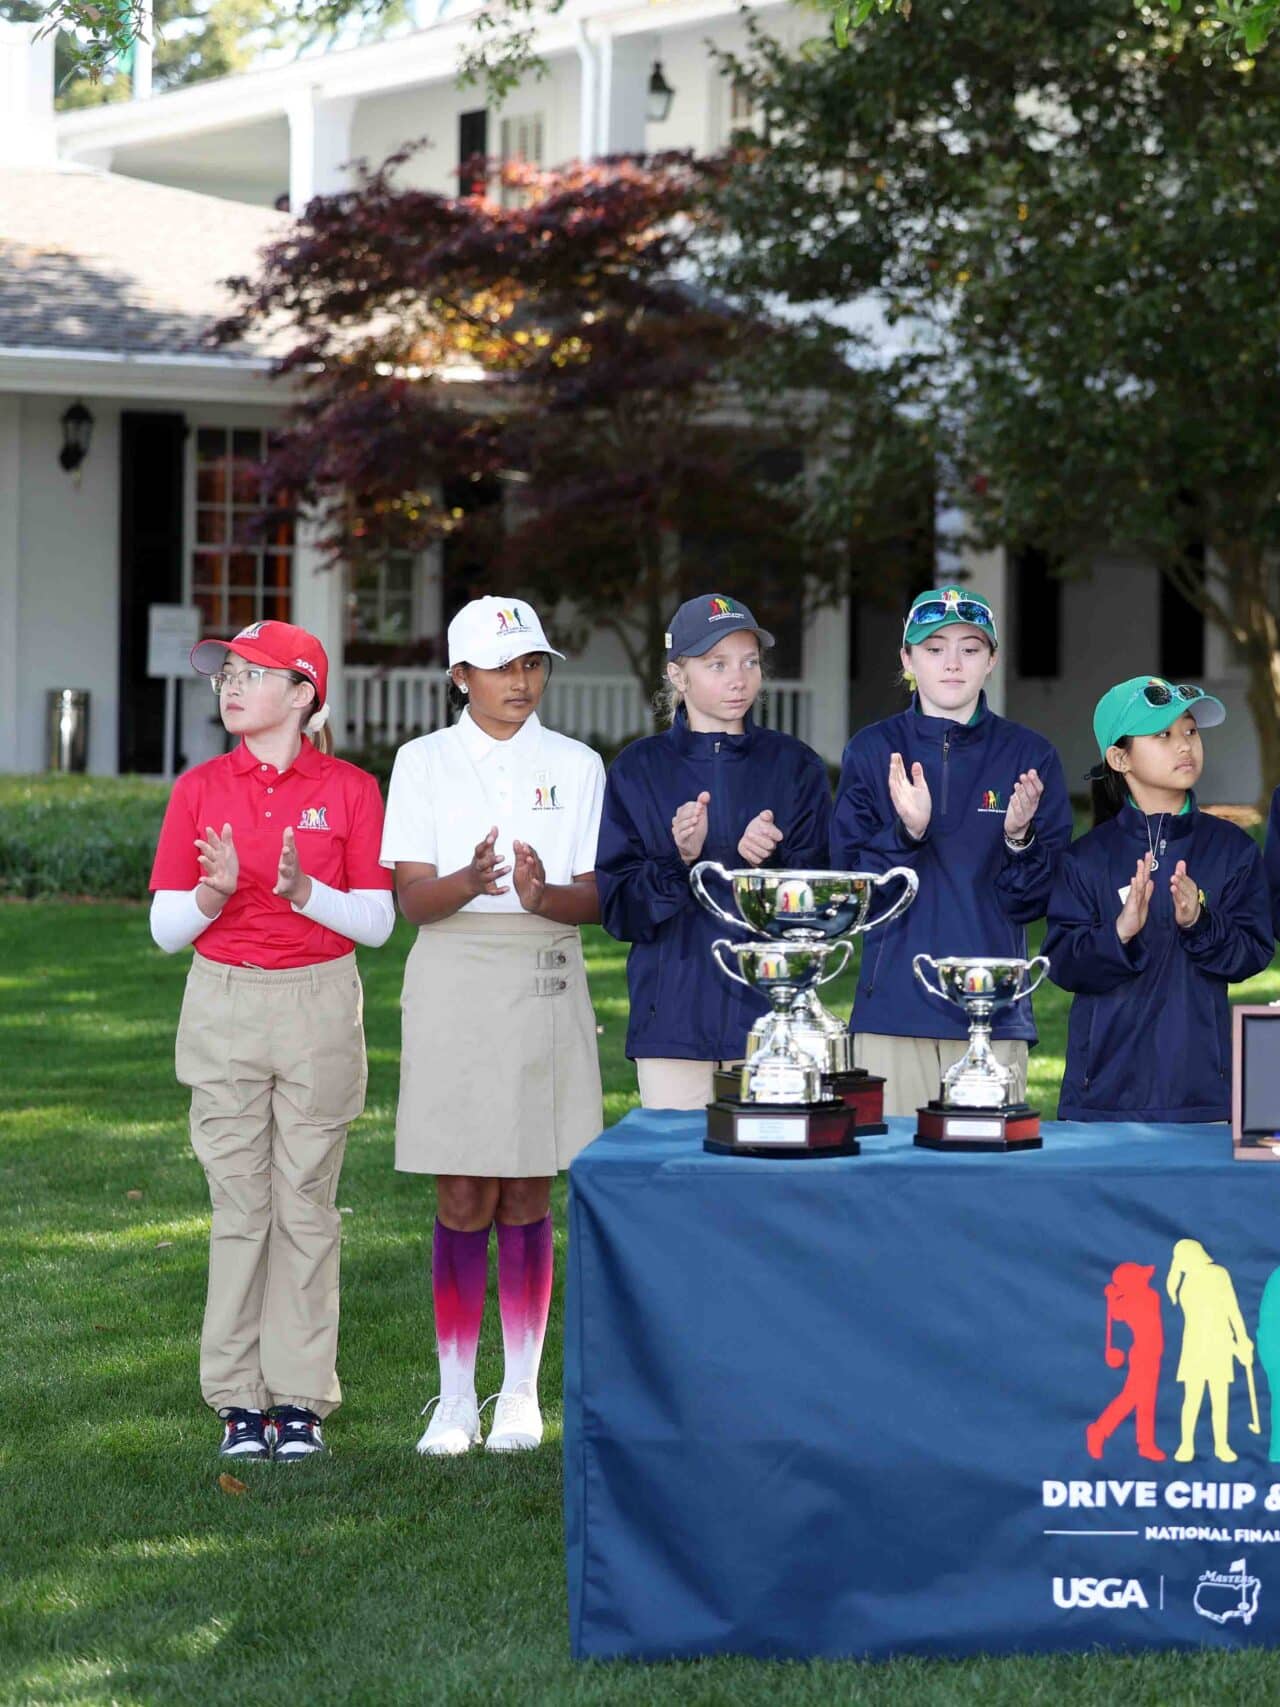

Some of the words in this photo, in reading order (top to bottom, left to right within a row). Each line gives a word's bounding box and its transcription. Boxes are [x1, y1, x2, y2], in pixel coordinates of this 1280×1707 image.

[1042, 1480, 1158, 1508] DRIVE
[1164, 1480, 1257, 1510] CHIP
[1144, 1525, 1232, 1541] NATIONAL
[1052, 1576, 1150, 1609] USGA
